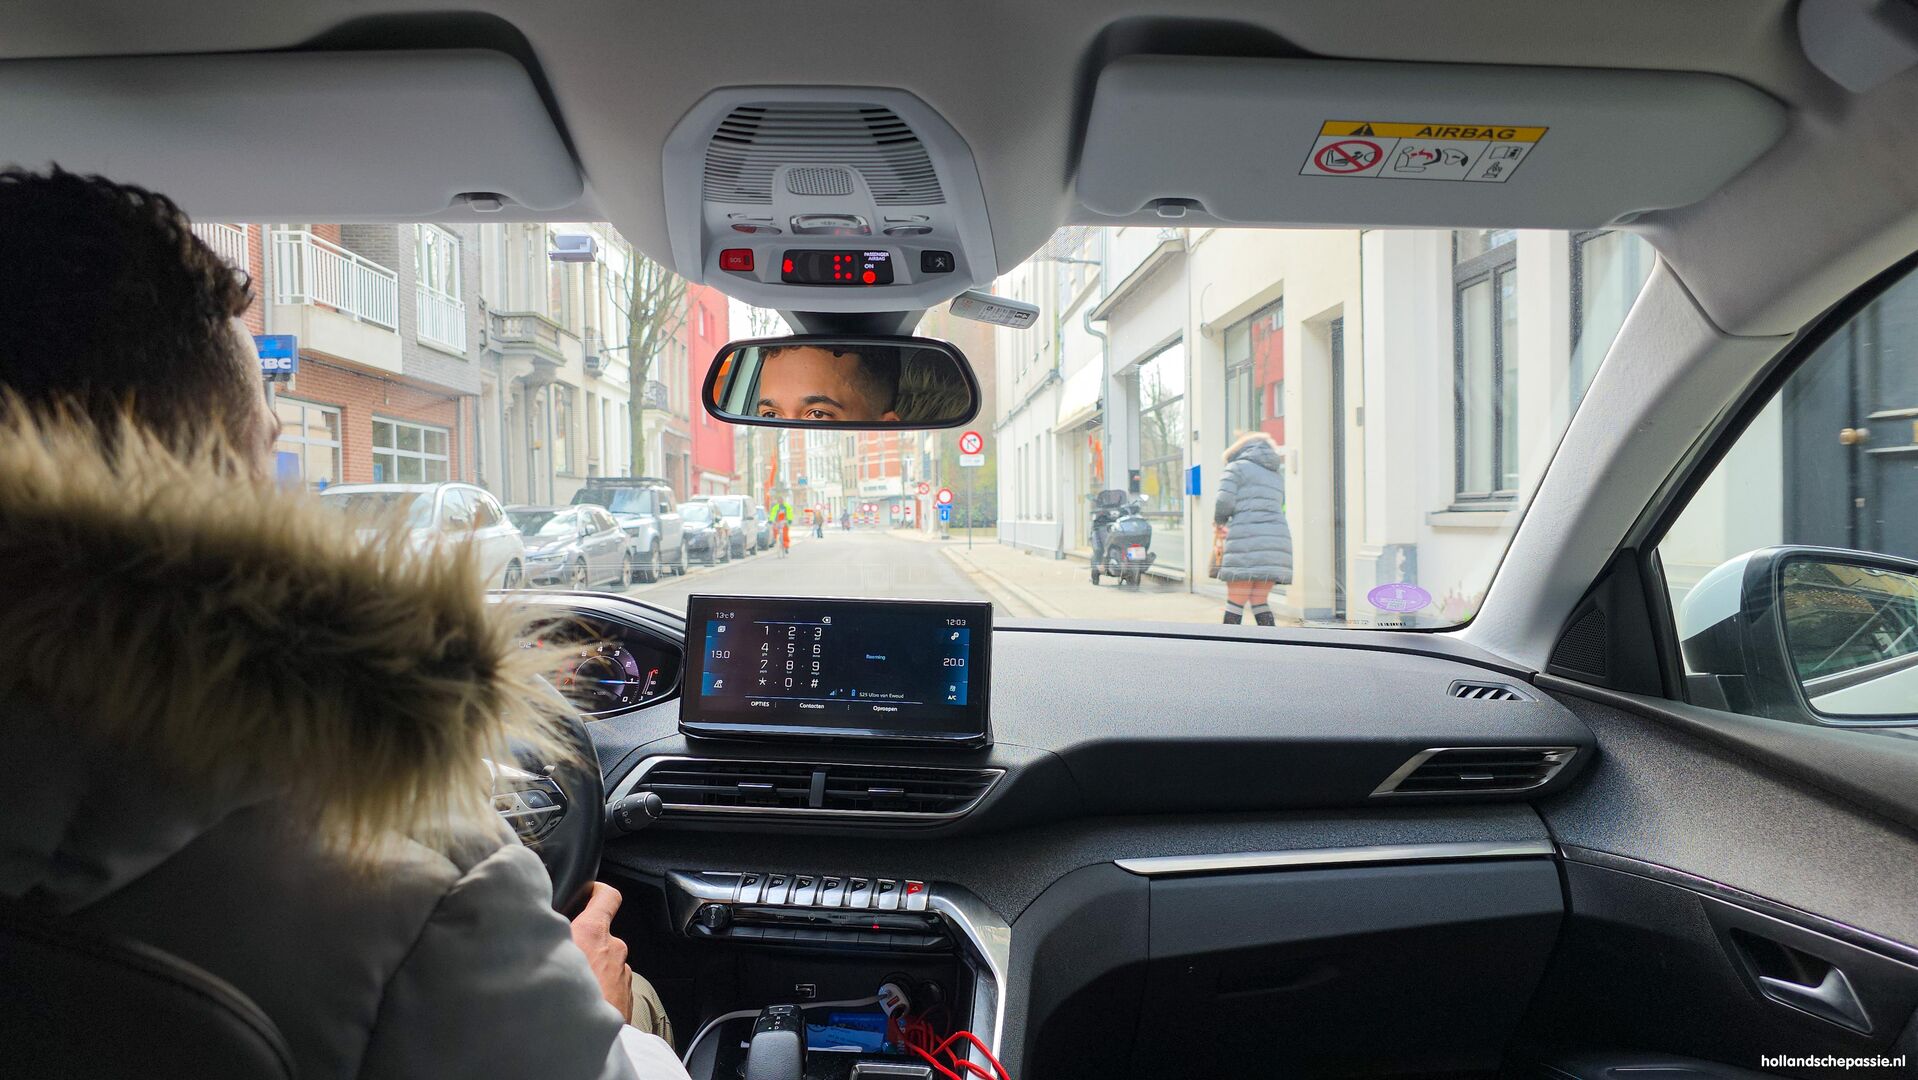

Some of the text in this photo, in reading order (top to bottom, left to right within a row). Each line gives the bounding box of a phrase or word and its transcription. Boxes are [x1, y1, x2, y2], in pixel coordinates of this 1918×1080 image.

[1416, 126, 1517, 140] AIRBAG
[765, 625, 822, 637] 1 2 3
[761, 642, 821, 654] 4 5 6
[711, 650, 731, 659] 19.0
[760, 659, 820, 671] 7 8 9
[943, 658, 965, 667] 20.0
[784, 677, 793, 688] 0
